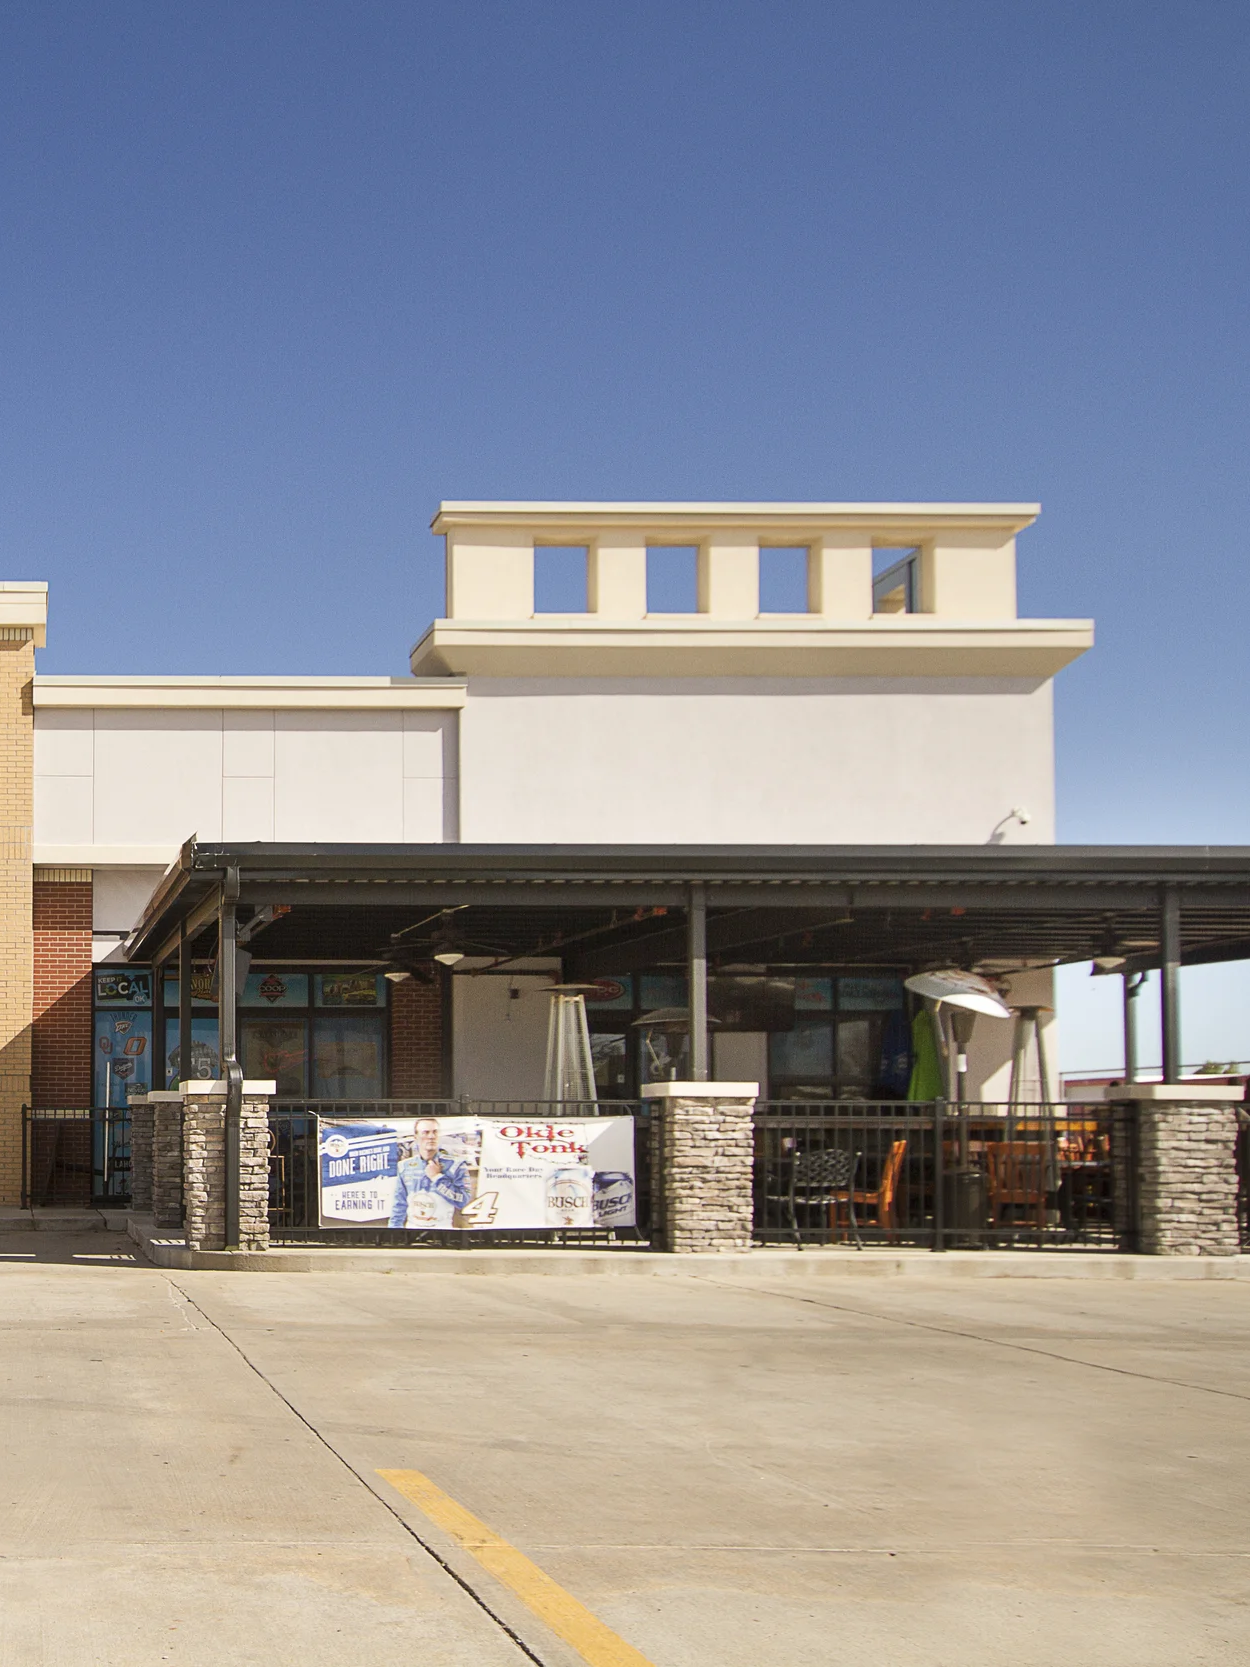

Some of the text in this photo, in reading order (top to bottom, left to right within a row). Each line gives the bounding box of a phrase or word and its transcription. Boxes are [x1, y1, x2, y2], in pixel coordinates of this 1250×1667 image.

[98, 982, 148, 996] LOCAL
[500, 1125, 574, 1142] Okie
[511, 1142, 589, 1159] Tonk
[329, 1157, 356, 1178] DONE
[335, 1200, 385, 1210] EARNING IT
[461, 1192, 499, 1224] 4
[547, 1196, 589, 1208] BUSCH
